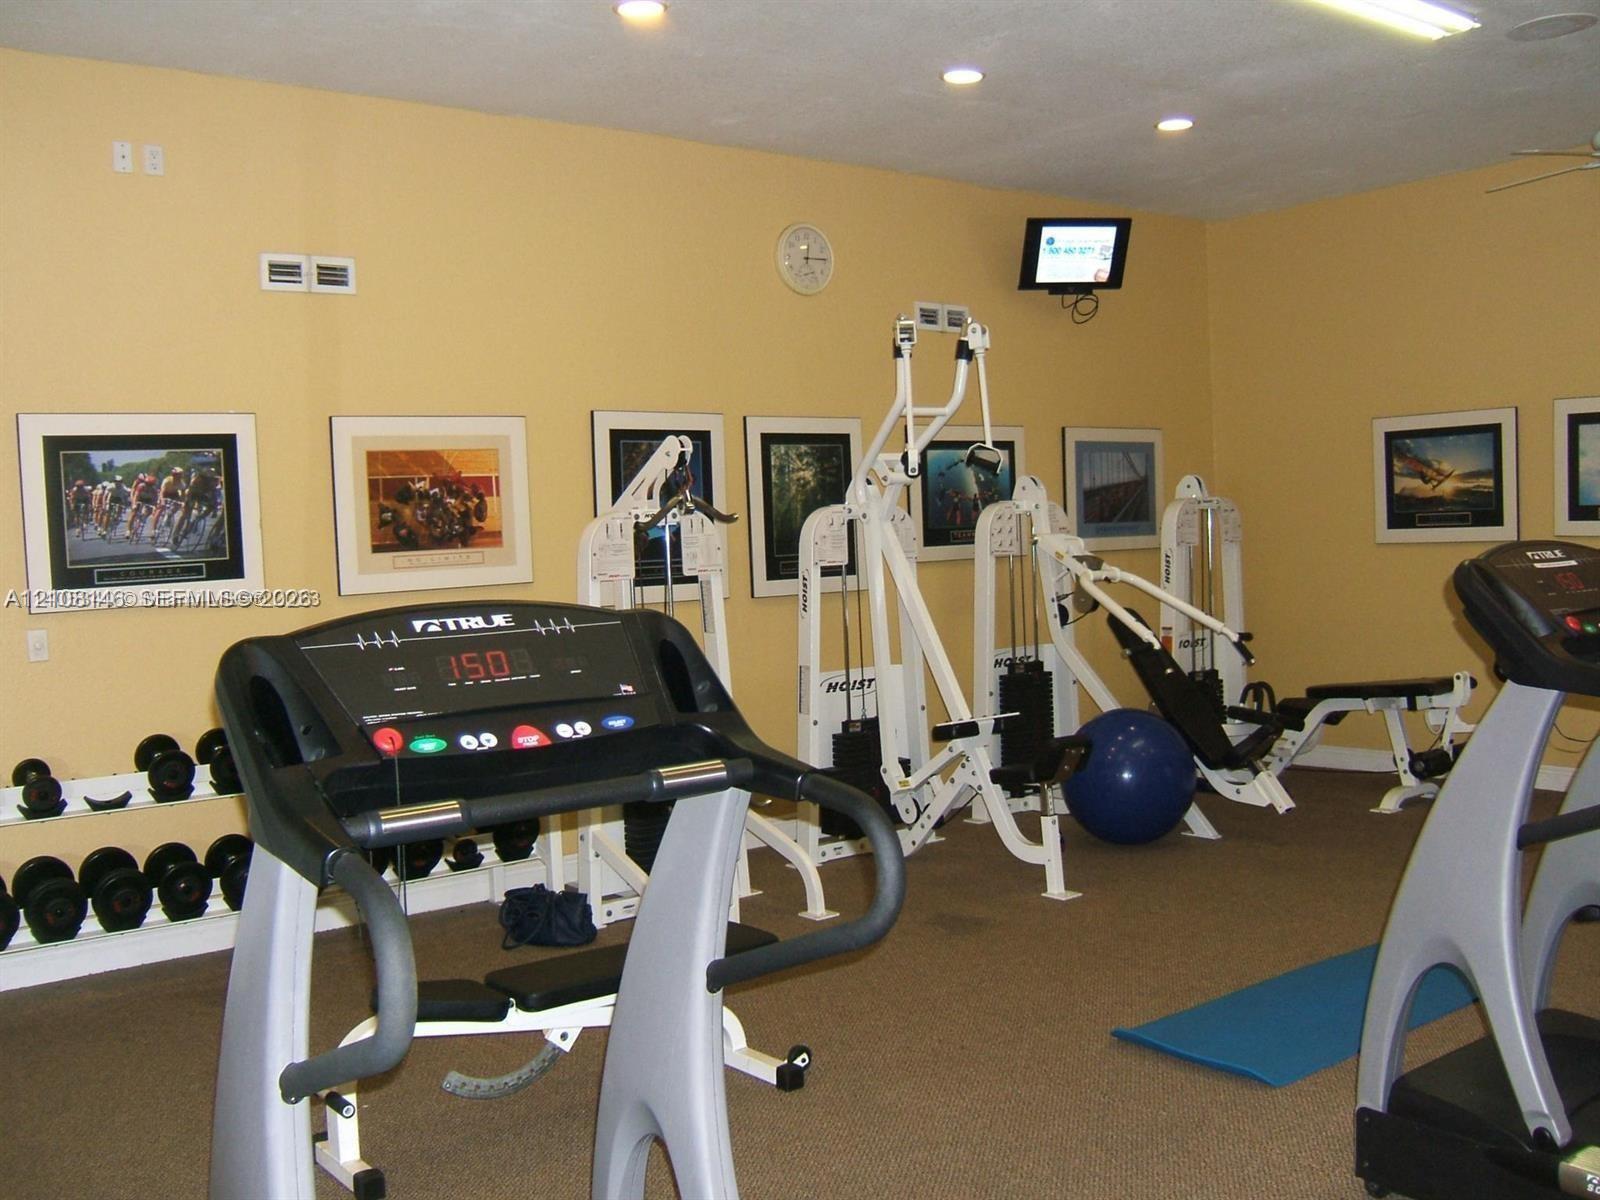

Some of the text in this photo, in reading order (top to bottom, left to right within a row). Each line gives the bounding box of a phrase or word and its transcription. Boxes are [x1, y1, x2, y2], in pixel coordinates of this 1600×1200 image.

[439, 613, 515, 631] TRUE
[449, 651, 510, 679] 150
[825, 677, 876, 693] HOIST
